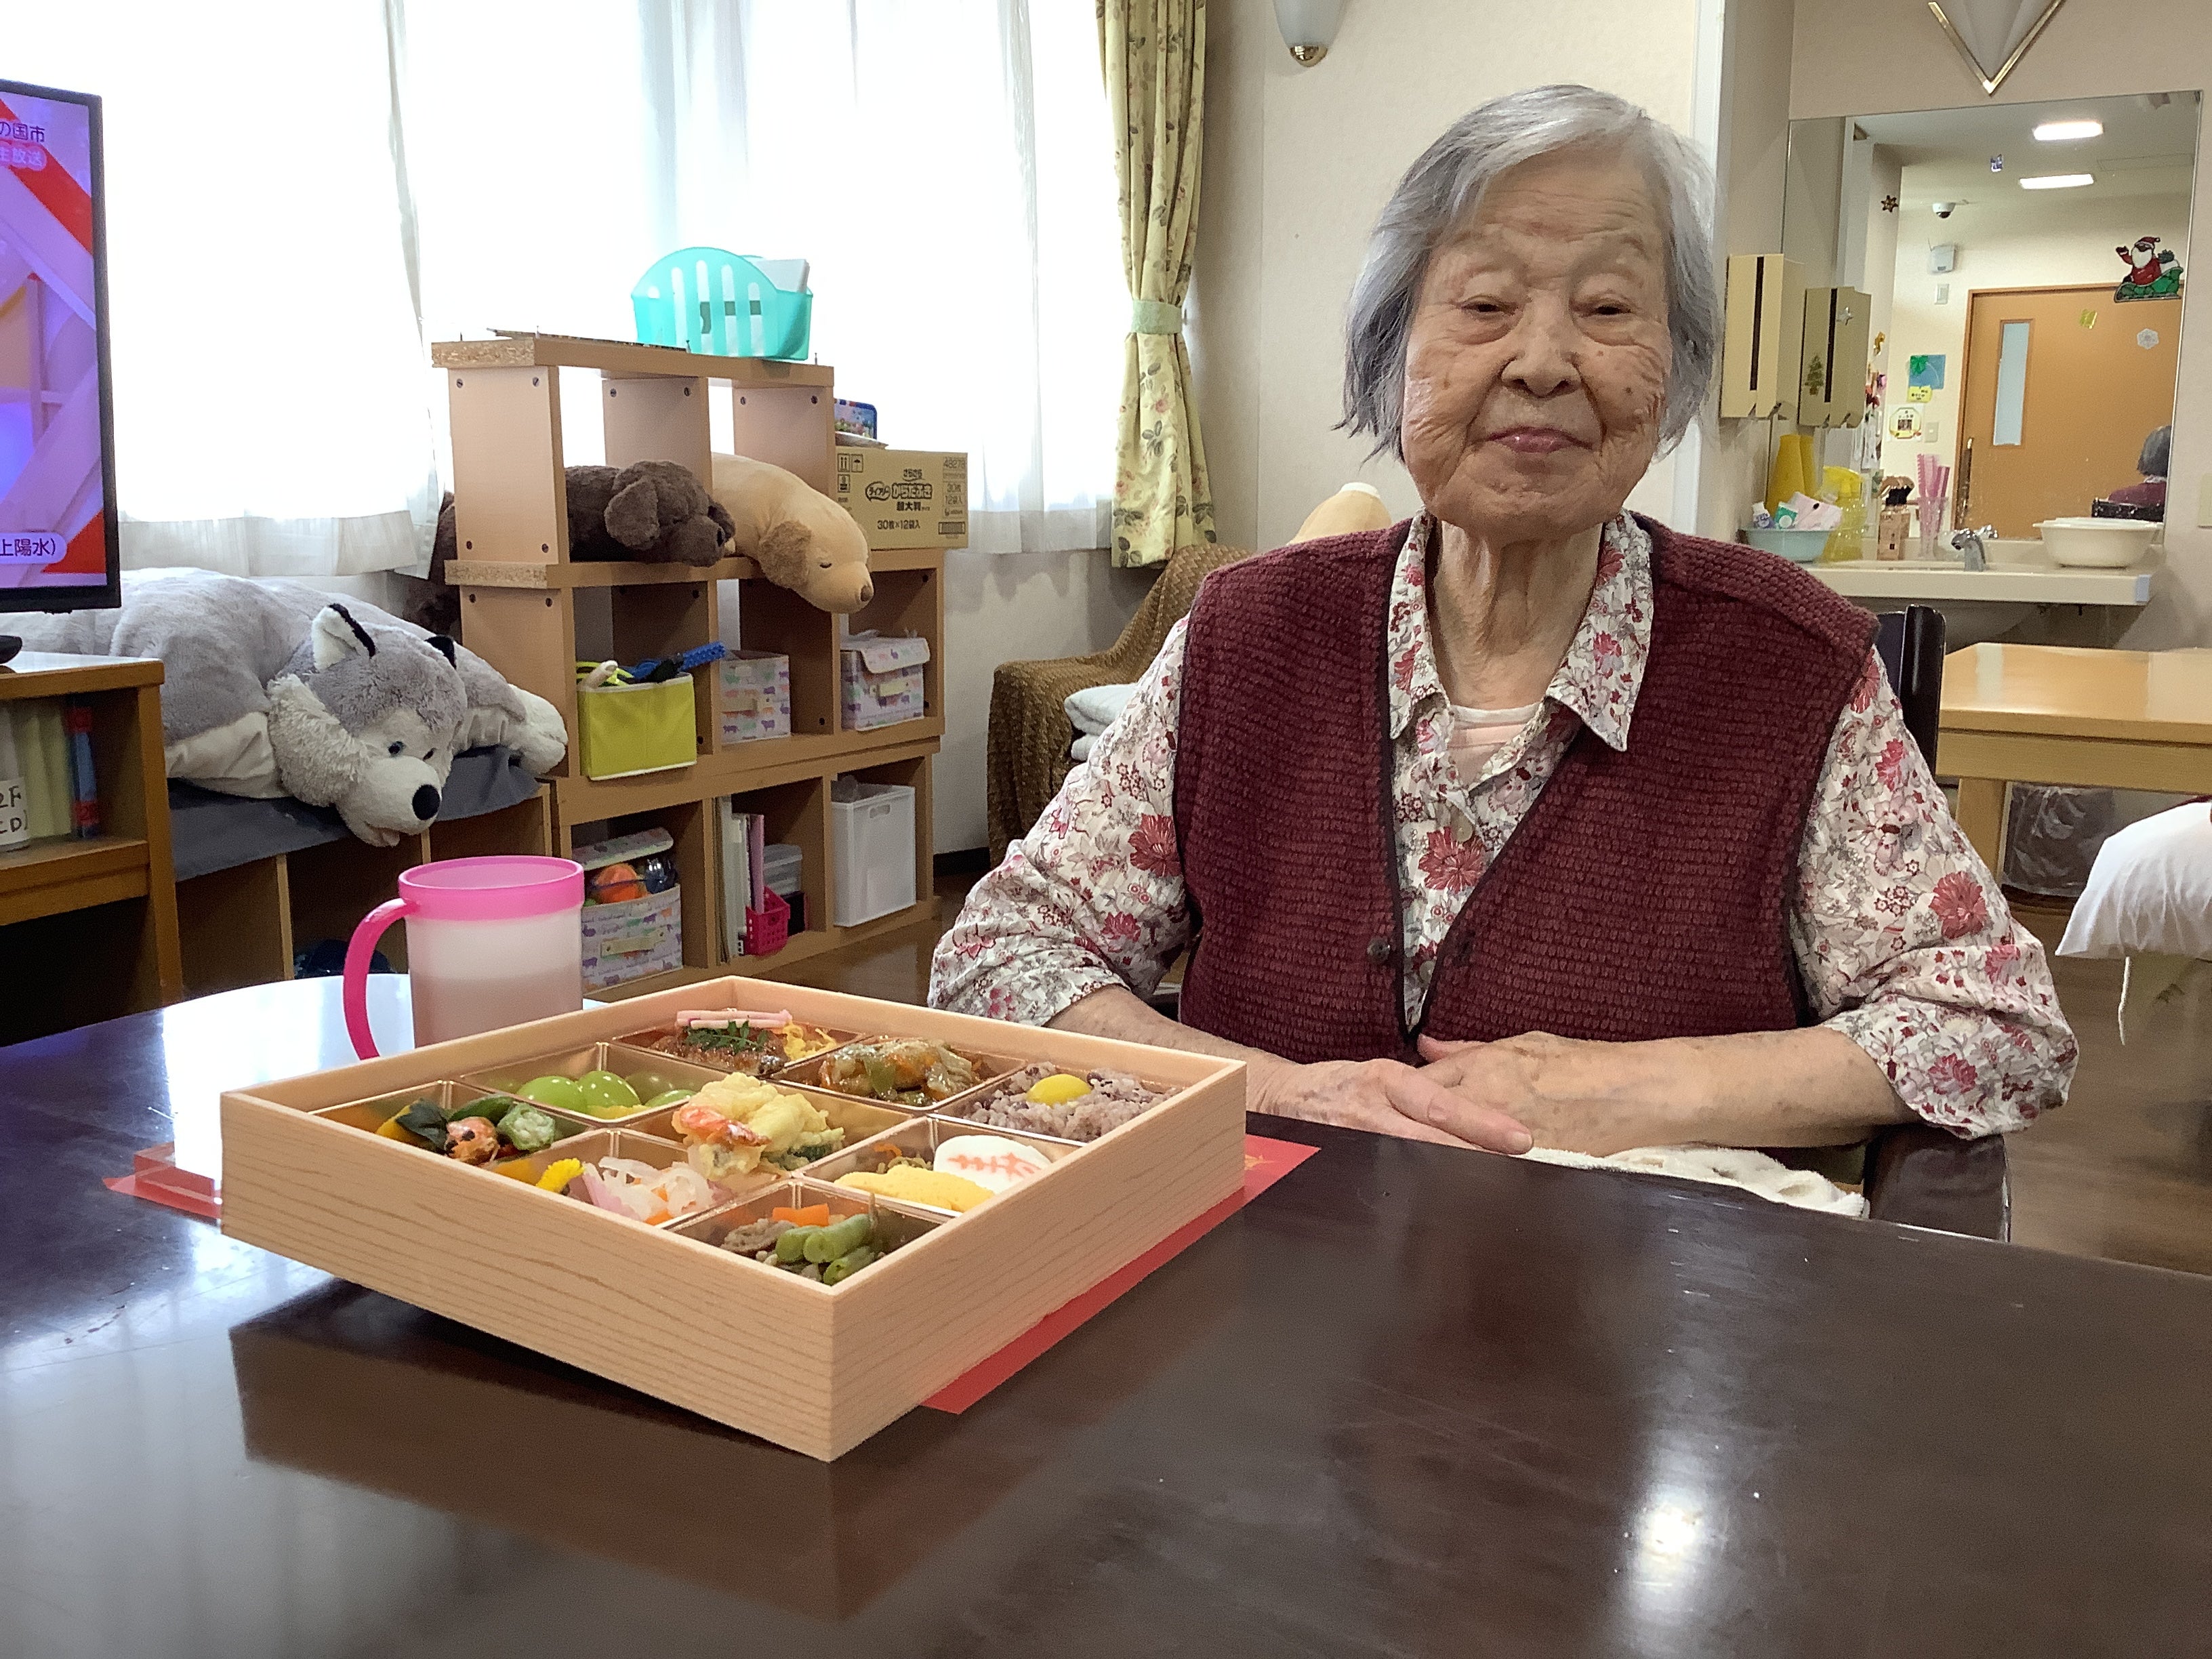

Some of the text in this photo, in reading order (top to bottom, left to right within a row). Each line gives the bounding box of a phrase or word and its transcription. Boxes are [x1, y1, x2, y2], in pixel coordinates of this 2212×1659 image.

[891, 483, 933, 499] からだふき
[0, 538, 56, 557] 上陽水)
